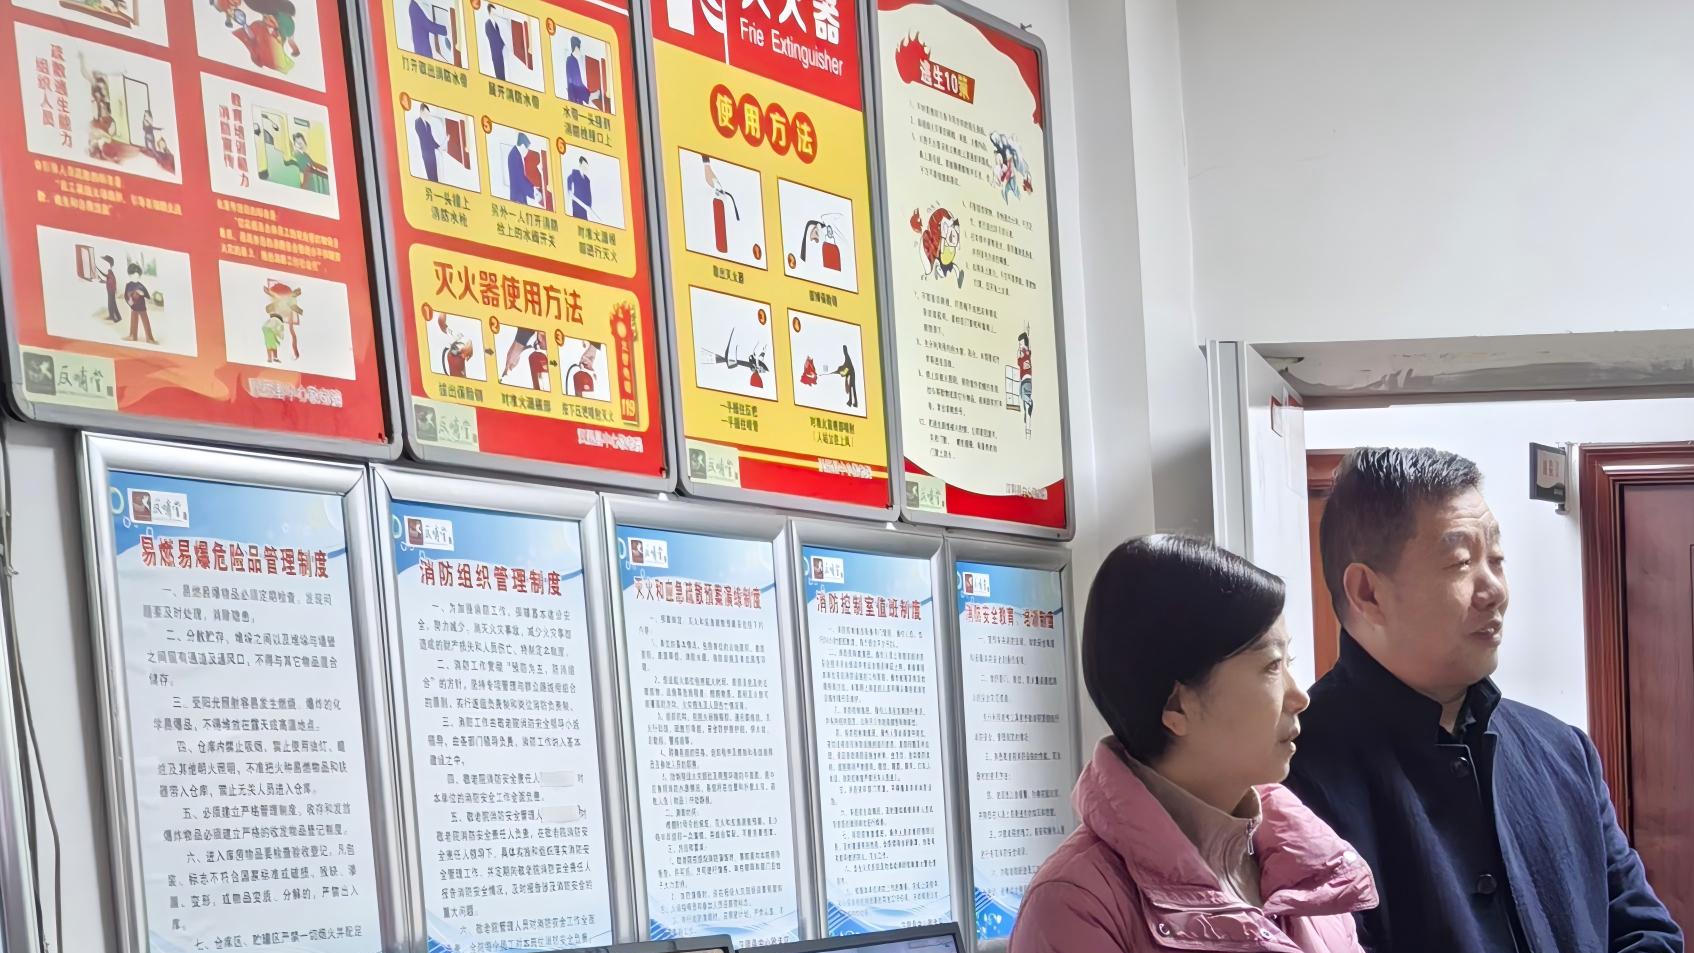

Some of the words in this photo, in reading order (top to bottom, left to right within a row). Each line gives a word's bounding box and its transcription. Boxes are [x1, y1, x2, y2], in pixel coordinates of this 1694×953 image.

[771, 29, 844, 76] Extinguisher
[715, 94, 813, 156] 使用方法
[433, 261, 584, 326] 灭火器使用方法
[621, 399, 636, 417] 119
[141, 536, 329, 579] 易燃易爆危险品管理制度
[419, 559, 562, 596] 消防组织管理制度
[817, 592, 922, 621] 消防控制室值班制度
